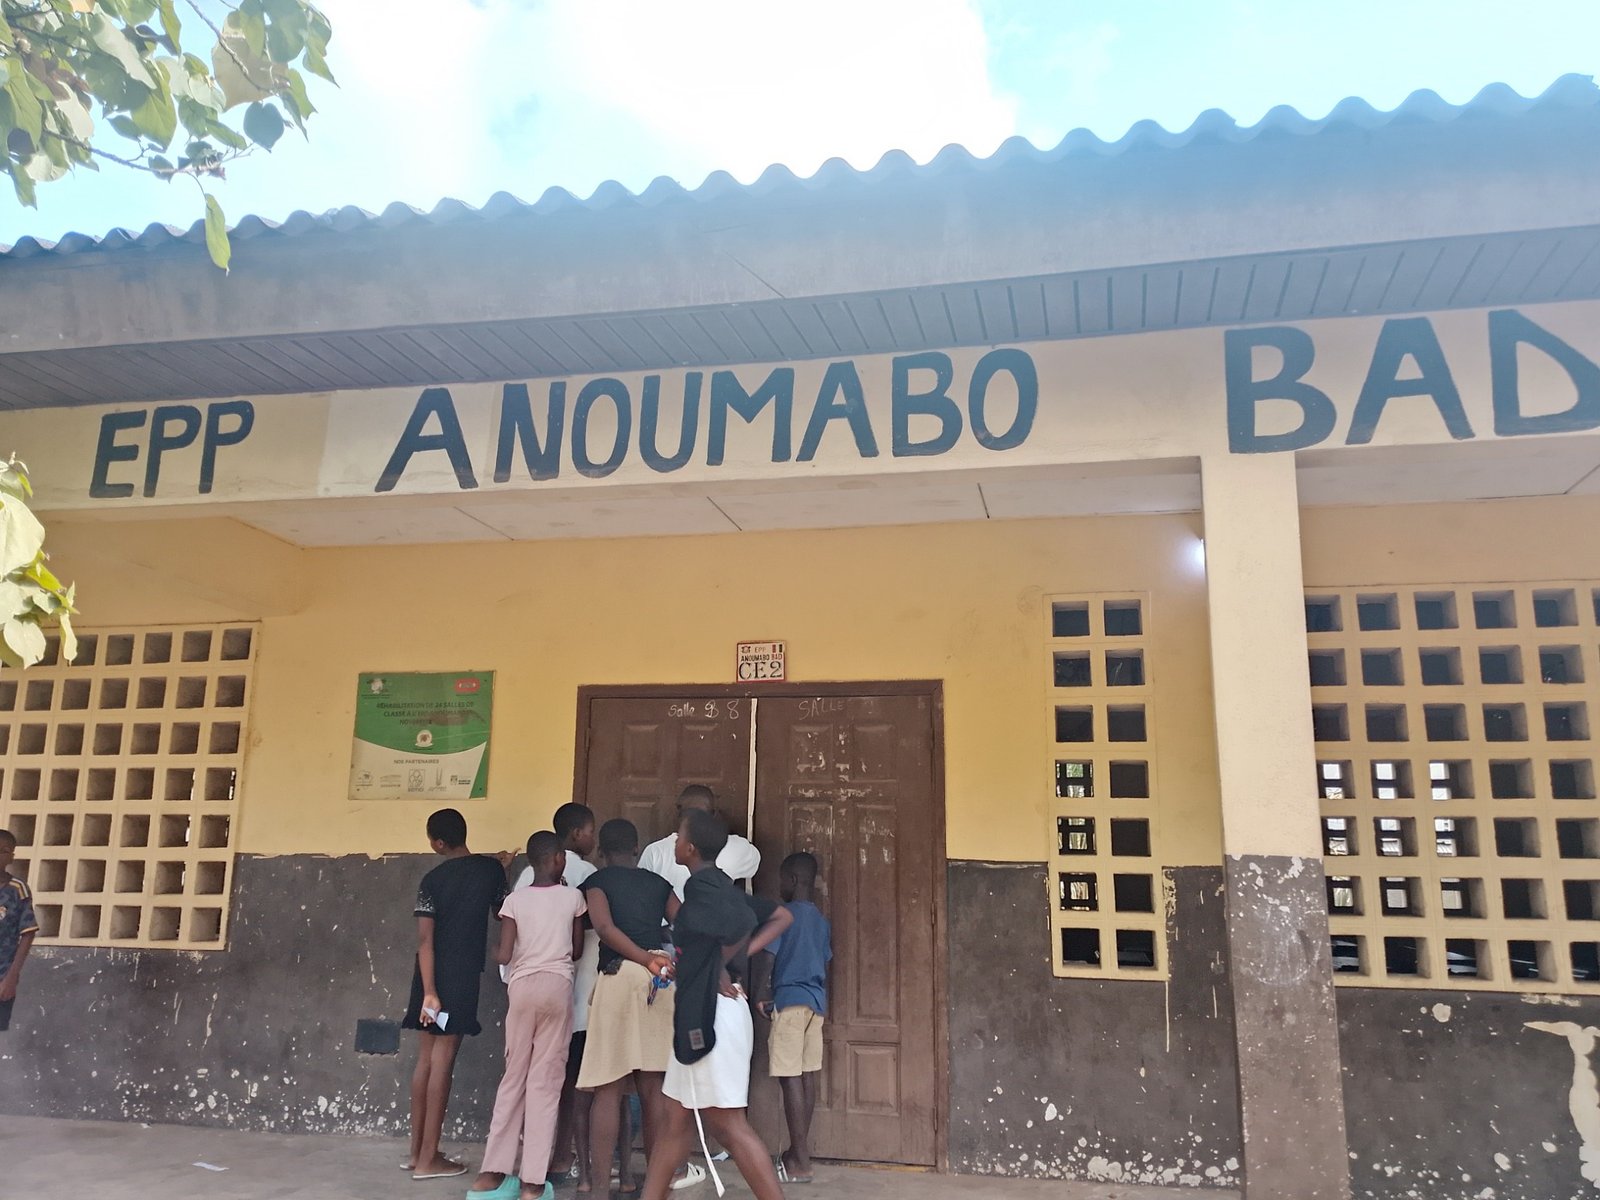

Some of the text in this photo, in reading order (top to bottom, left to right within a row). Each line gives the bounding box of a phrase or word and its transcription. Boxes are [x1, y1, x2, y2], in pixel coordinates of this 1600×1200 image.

[89, 308, 1600, 498] EPP ANOUMABO BAD
[726, 699, 739, 719] 8
